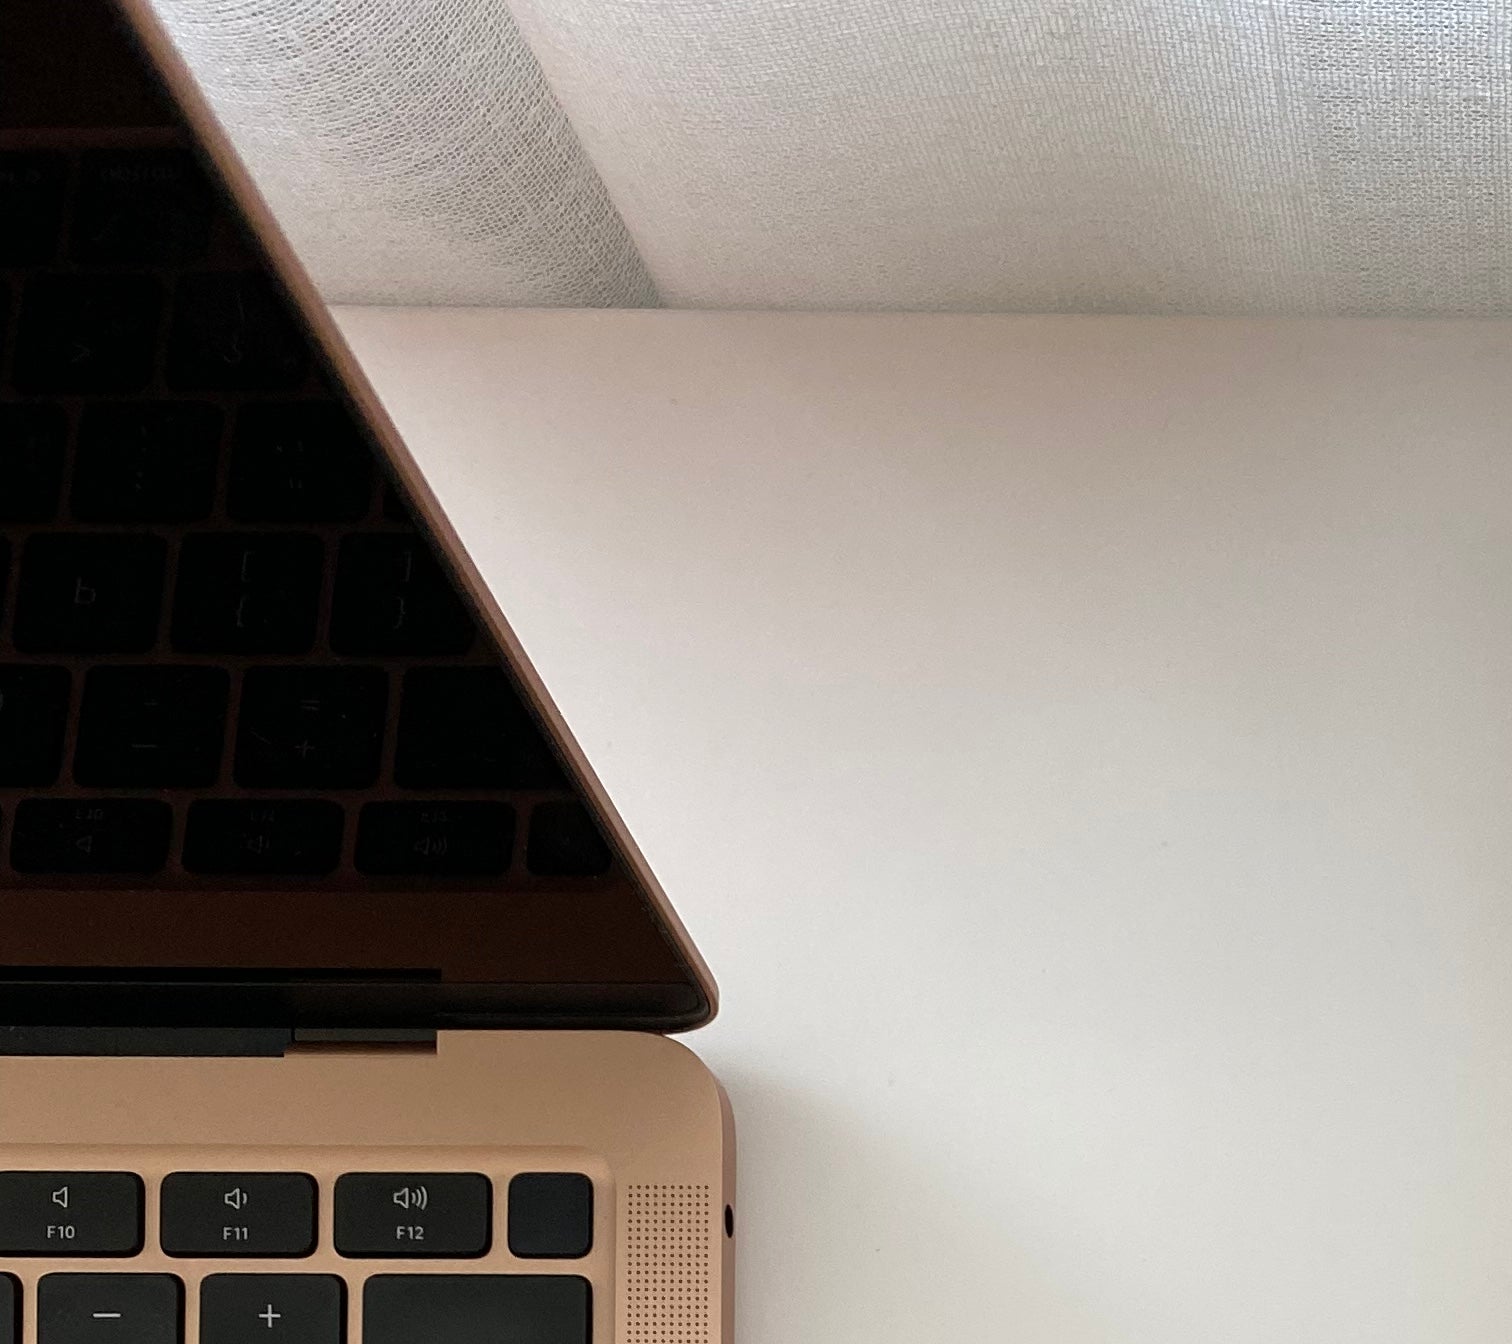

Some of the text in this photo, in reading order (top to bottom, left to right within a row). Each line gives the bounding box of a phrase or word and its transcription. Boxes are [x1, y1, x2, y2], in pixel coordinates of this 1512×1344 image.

[47, 1225, 75, 1239] F10
[223, 1226, 249, 1240] F11
[396, 1226, 424, 1240] F12
